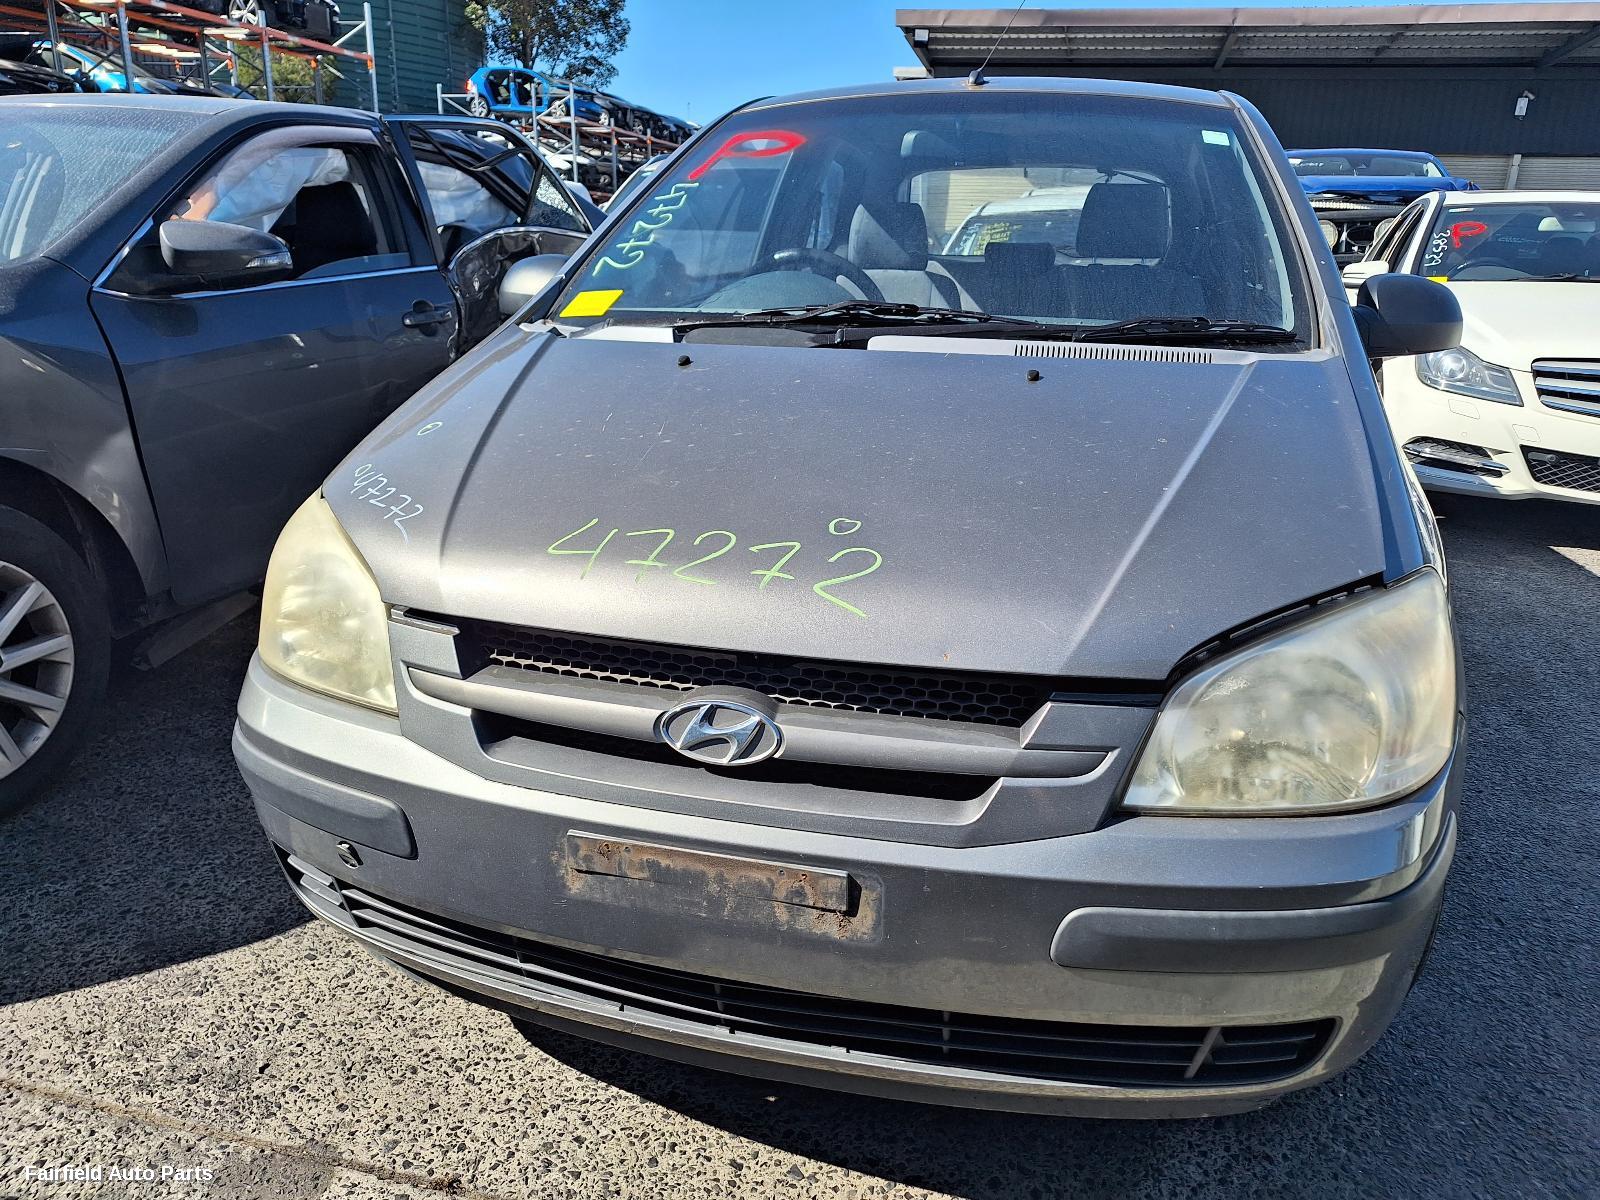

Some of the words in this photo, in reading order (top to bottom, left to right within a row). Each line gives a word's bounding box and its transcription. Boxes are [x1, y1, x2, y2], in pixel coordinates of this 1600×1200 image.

[688, 129, 807, 180] P
[592, 182, 700, 277] 47272
[350, 472, 424, 544] 47272
[547, 517, 883, 618] 47272
